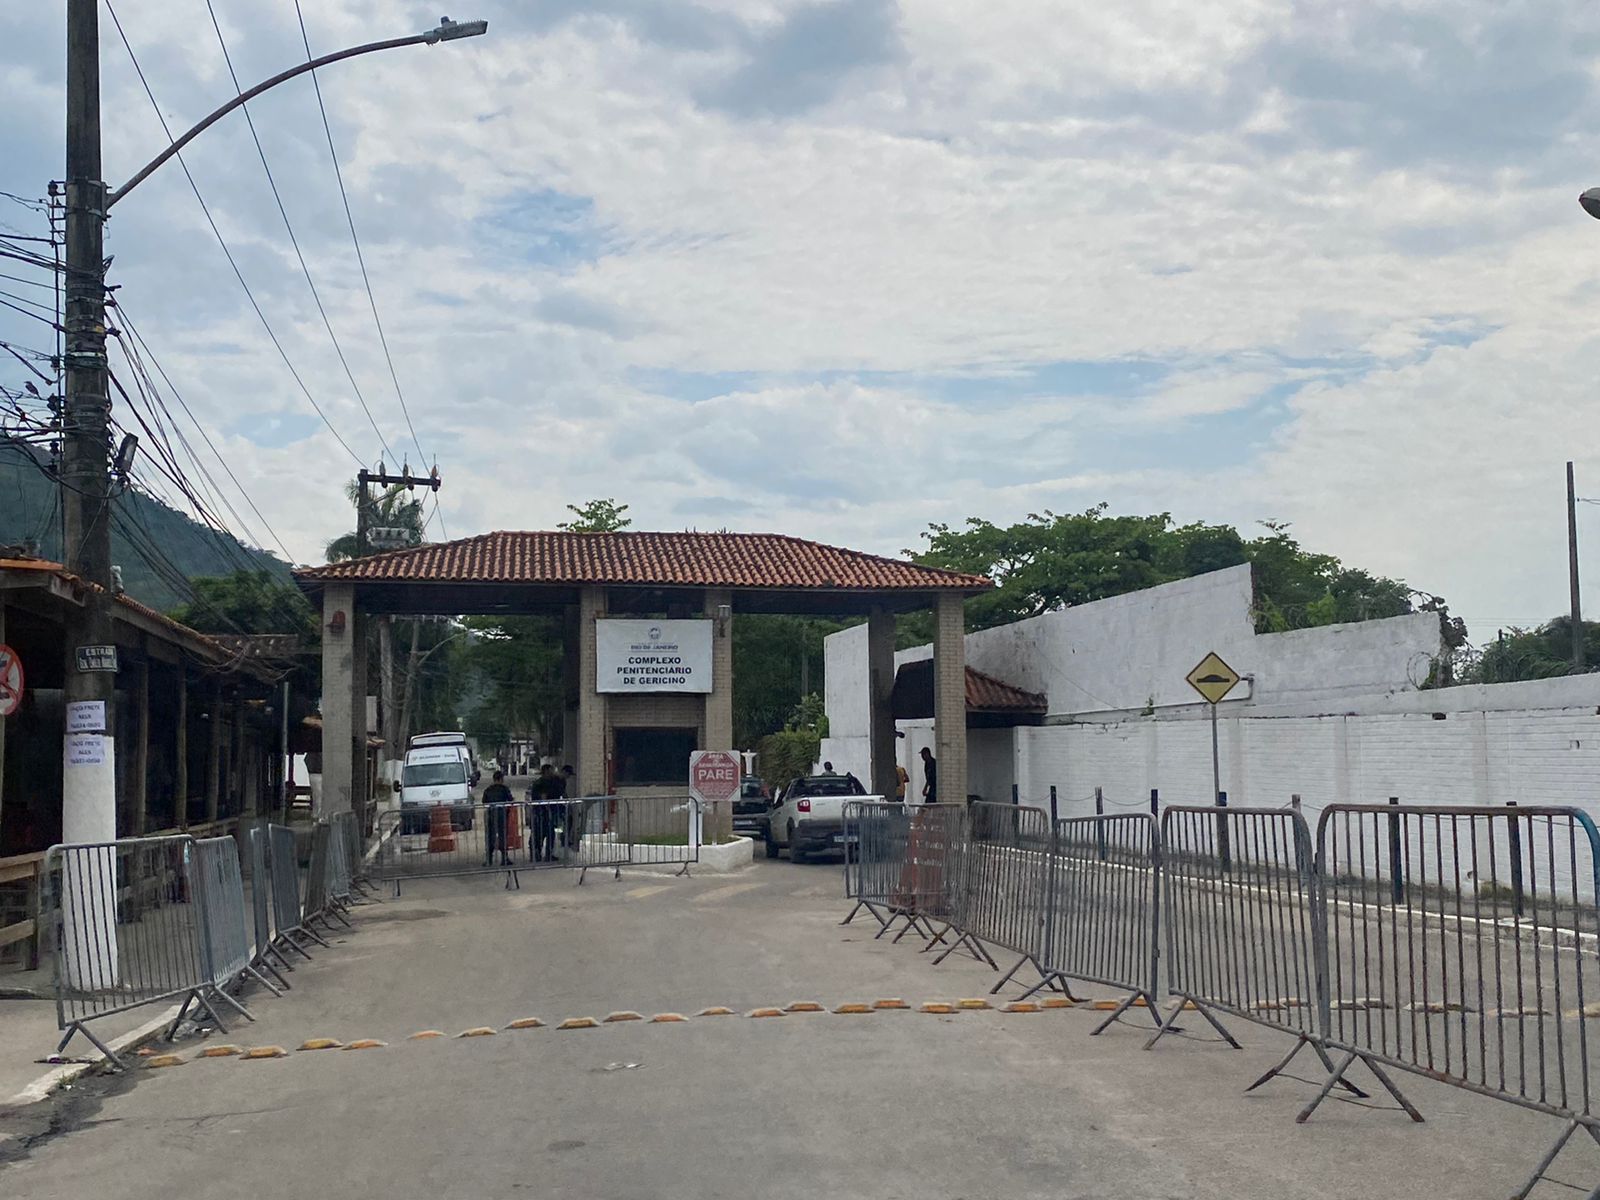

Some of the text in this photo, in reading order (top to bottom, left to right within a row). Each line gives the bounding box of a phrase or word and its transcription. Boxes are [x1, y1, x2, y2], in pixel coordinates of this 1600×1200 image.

[628, 656, 681, 664] COMPLEXO
[623, 677, 636, 685] DE
[698, 769, 733, 780] PARE
